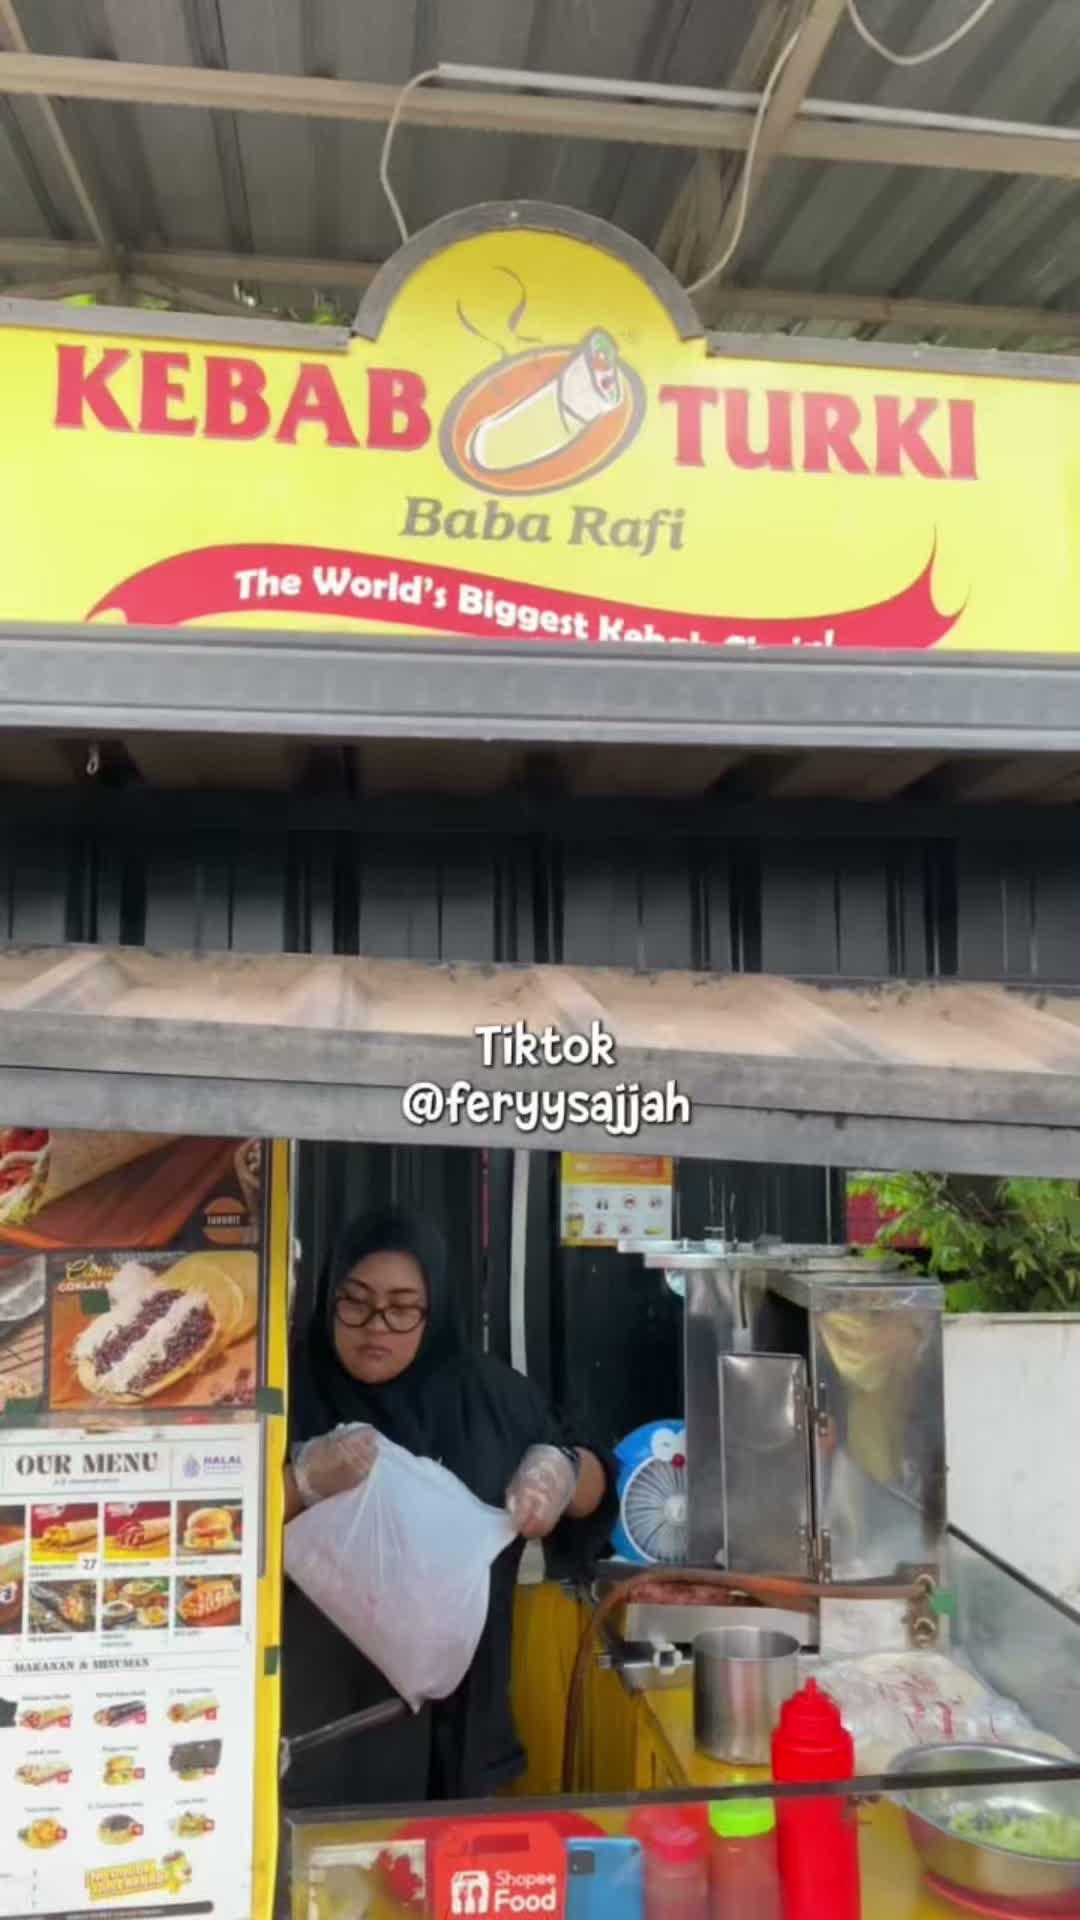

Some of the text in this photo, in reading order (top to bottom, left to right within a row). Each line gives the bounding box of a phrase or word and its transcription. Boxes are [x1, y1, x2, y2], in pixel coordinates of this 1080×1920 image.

[54, 343, 979, 480] KEBAB TURKI
[399, 496, 686, 557] Baba Rafi
[234, 568, 303, 600] The
[312, 566, 447, 609] World's
[458, 584, 590, 641] Biggest
[16, 1452, 158, 1476] OUR MENU
[203, 1455, 242, 1465] HALAL
[494, 1870, 556, 1888] Shopee
[494, 1887, 557, 1912] Food
